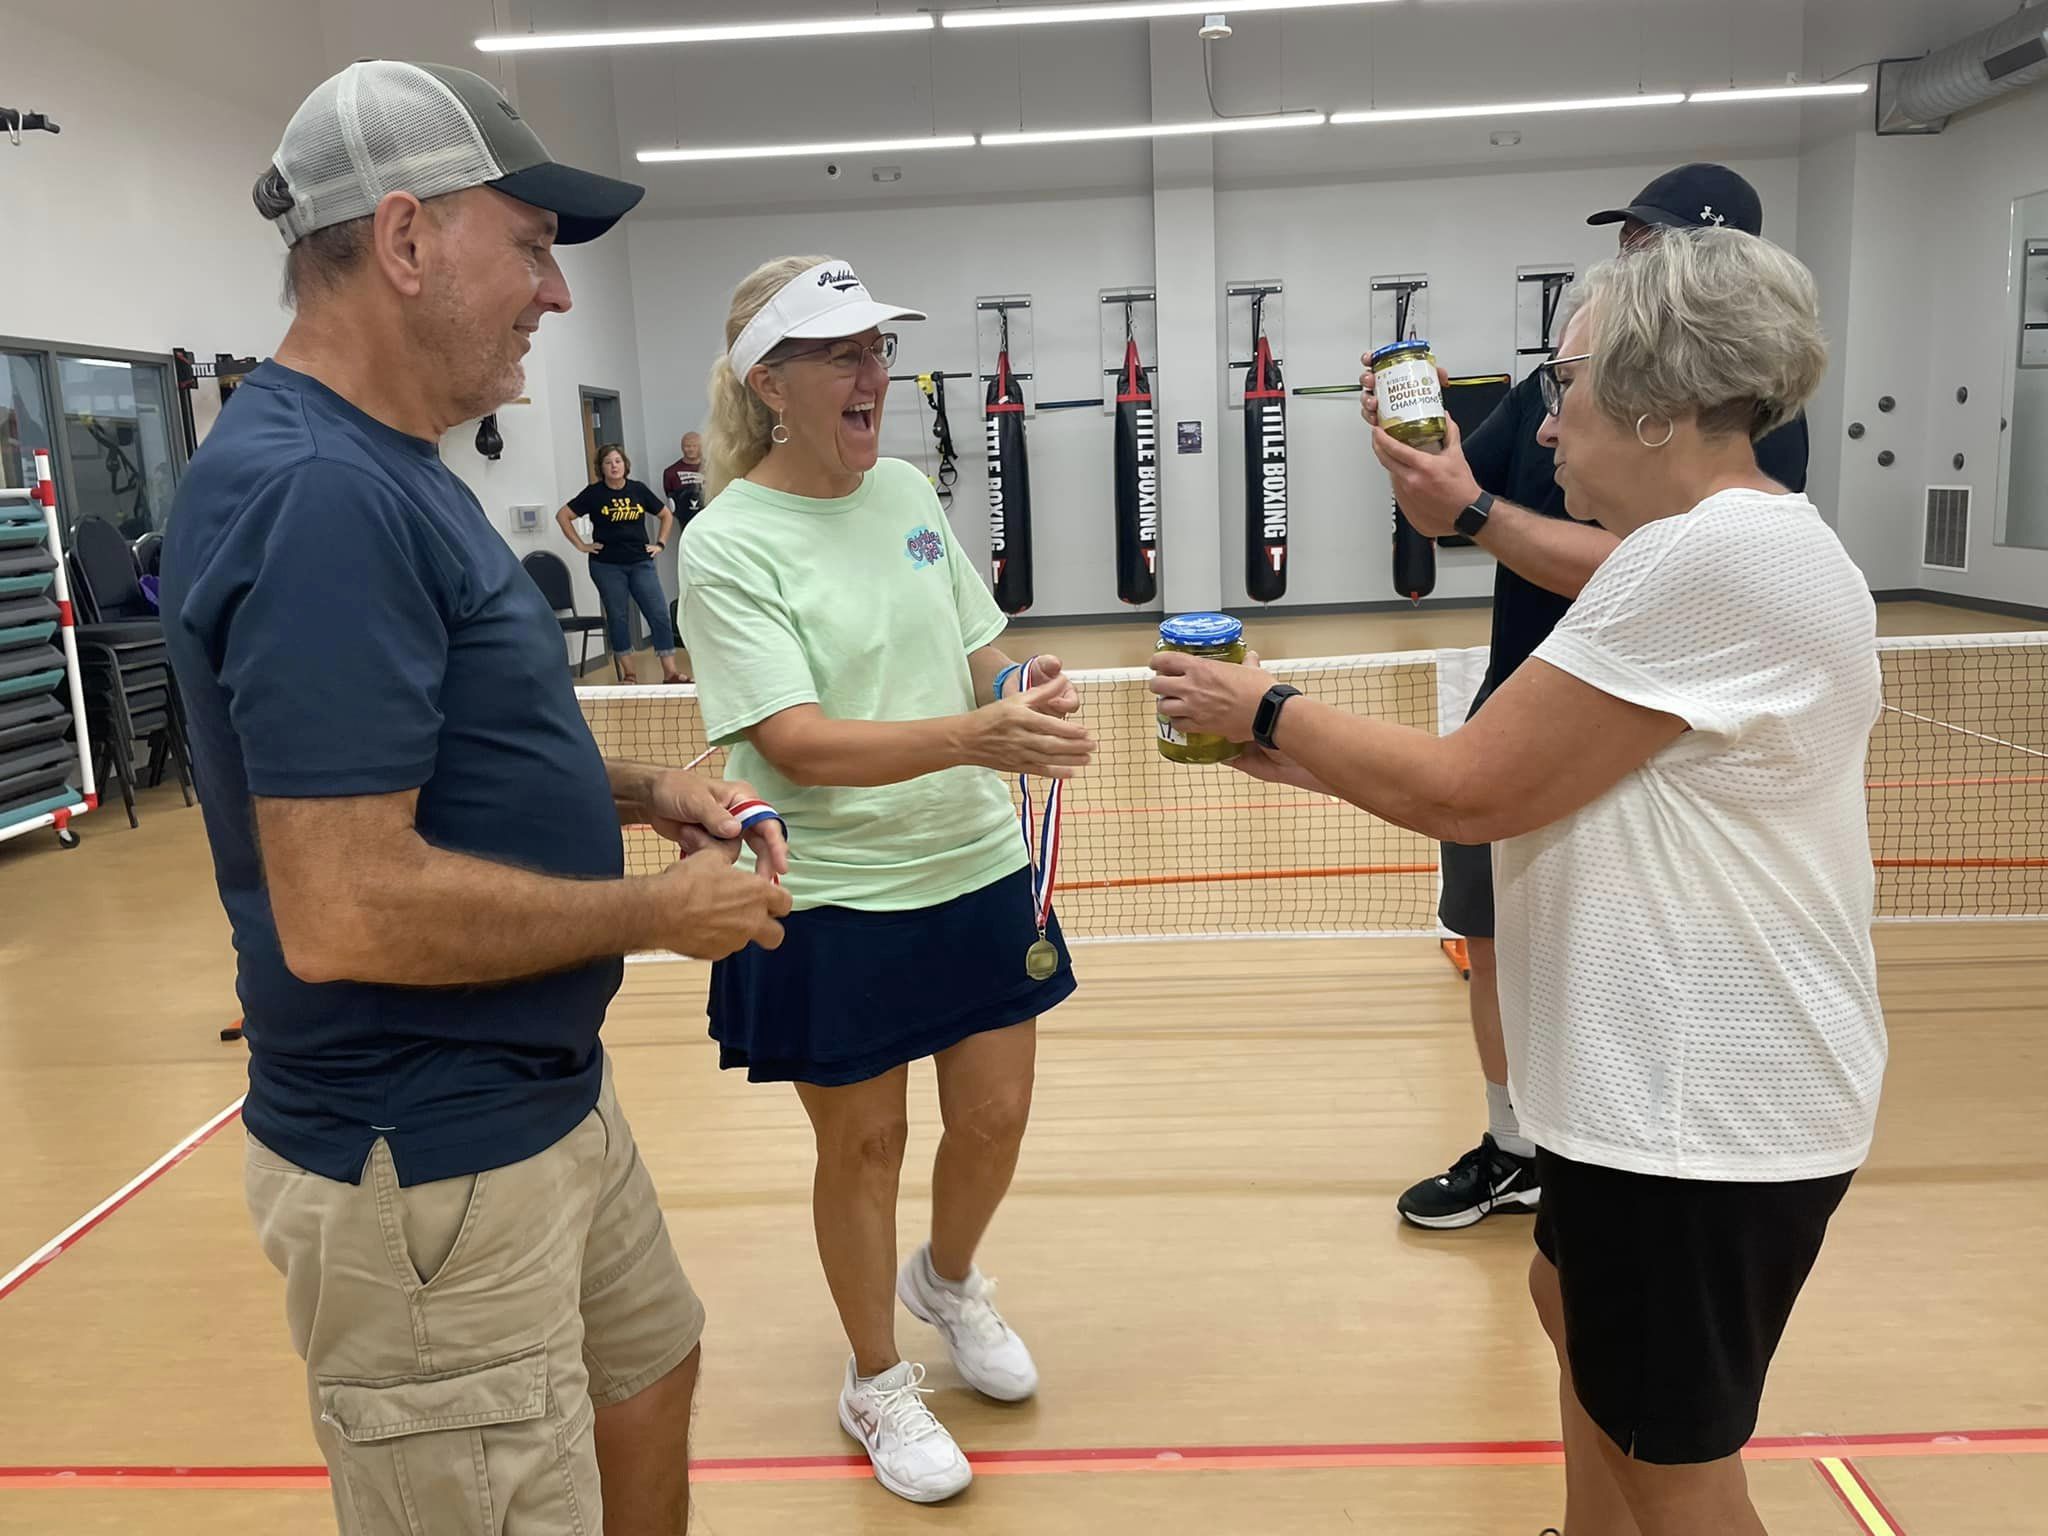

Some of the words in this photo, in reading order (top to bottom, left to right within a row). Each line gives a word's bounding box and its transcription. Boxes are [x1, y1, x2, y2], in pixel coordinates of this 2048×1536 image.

[191, 364, 216, 377] TITLE
[1387, 380, 1420, 395] MIXED
[1262, 402, 1285, 459] TITLE
[1138, 466, 1157, 541] BOXING
[1262, 462, 1287, 538] BOXING
